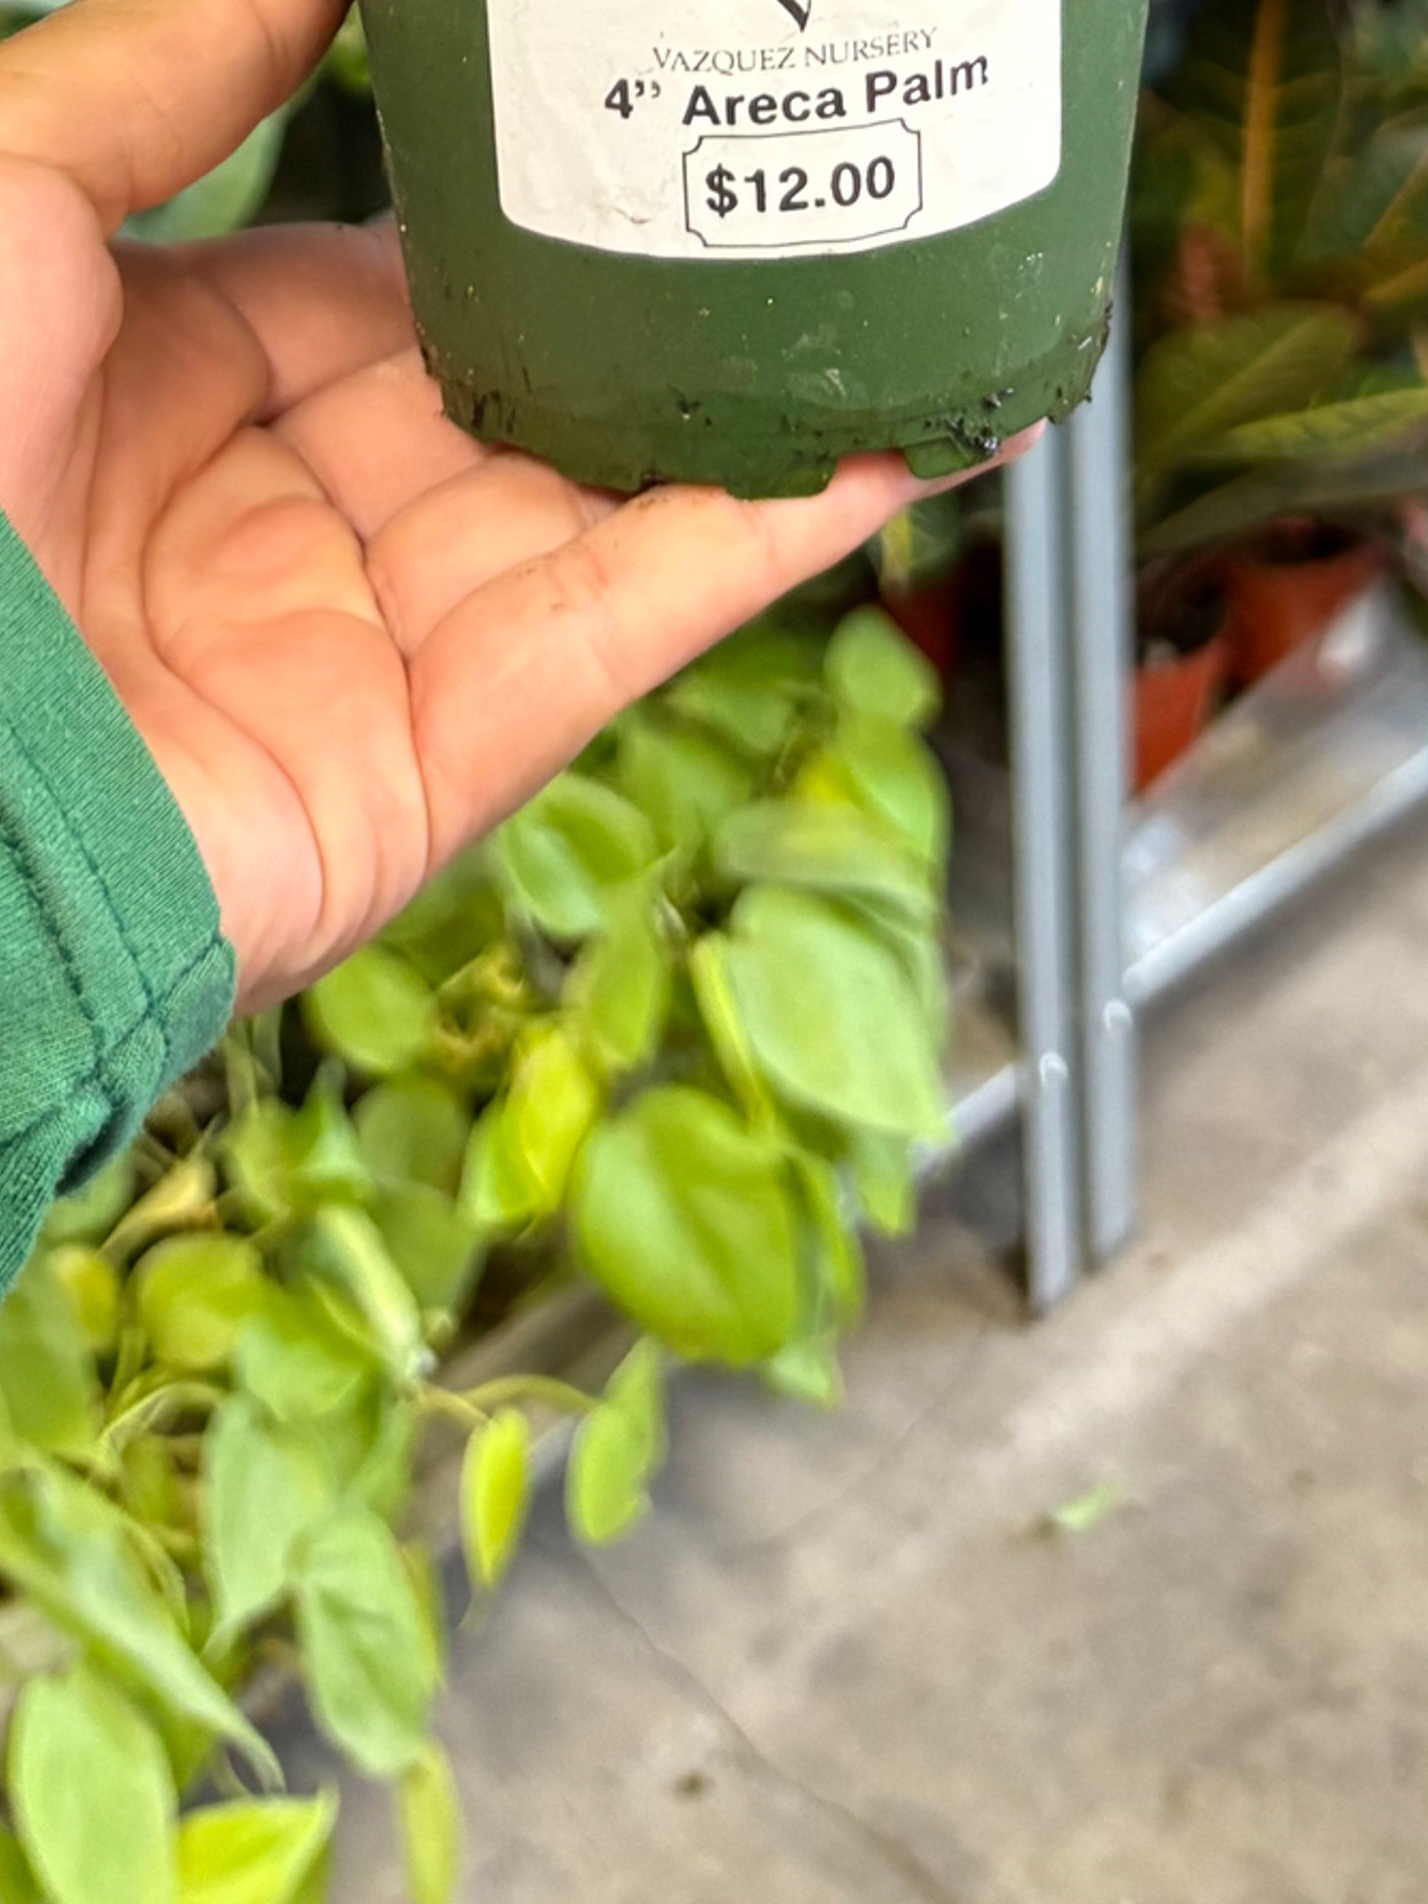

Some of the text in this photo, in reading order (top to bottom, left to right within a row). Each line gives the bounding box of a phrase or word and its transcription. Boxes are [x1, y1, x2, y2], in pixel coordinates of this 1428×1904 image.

[653, 28, 937, 76] VAZQUEZ NURSERY
[682, 84, 846, 126] Areca
[866, 55, 990, 113] Palm
[705, 156, 895, 218] $12.00
